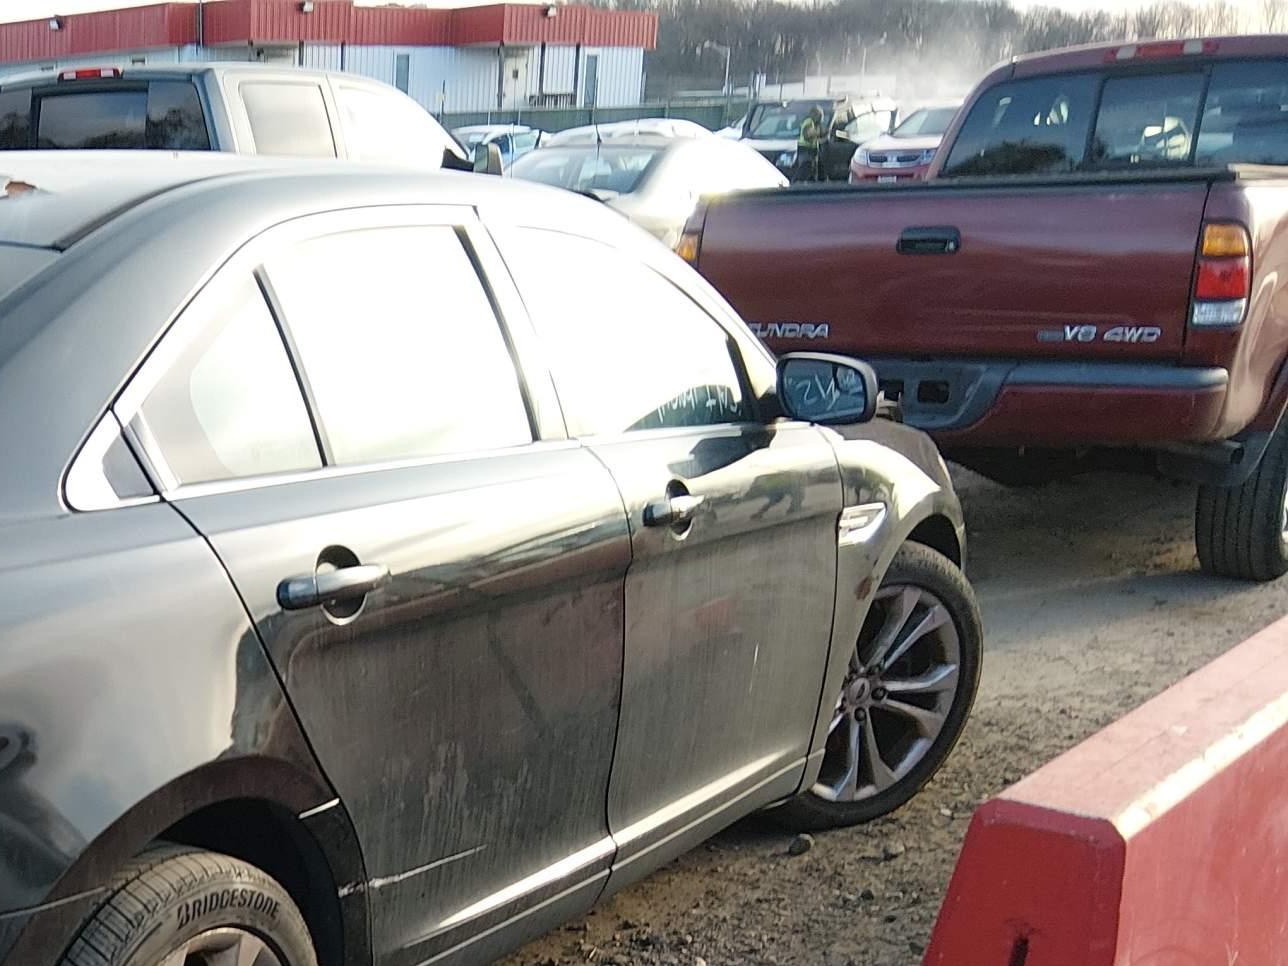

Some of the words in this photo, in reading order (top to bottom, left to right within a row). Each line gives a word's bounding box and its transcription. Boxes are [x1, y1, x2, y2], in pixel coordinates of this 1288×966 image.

[1064, 324, 1097, 342] V8
[1103, 326, 1161, 342] 4WD
[177, 888, 281, 931] BRIDGESTONE
